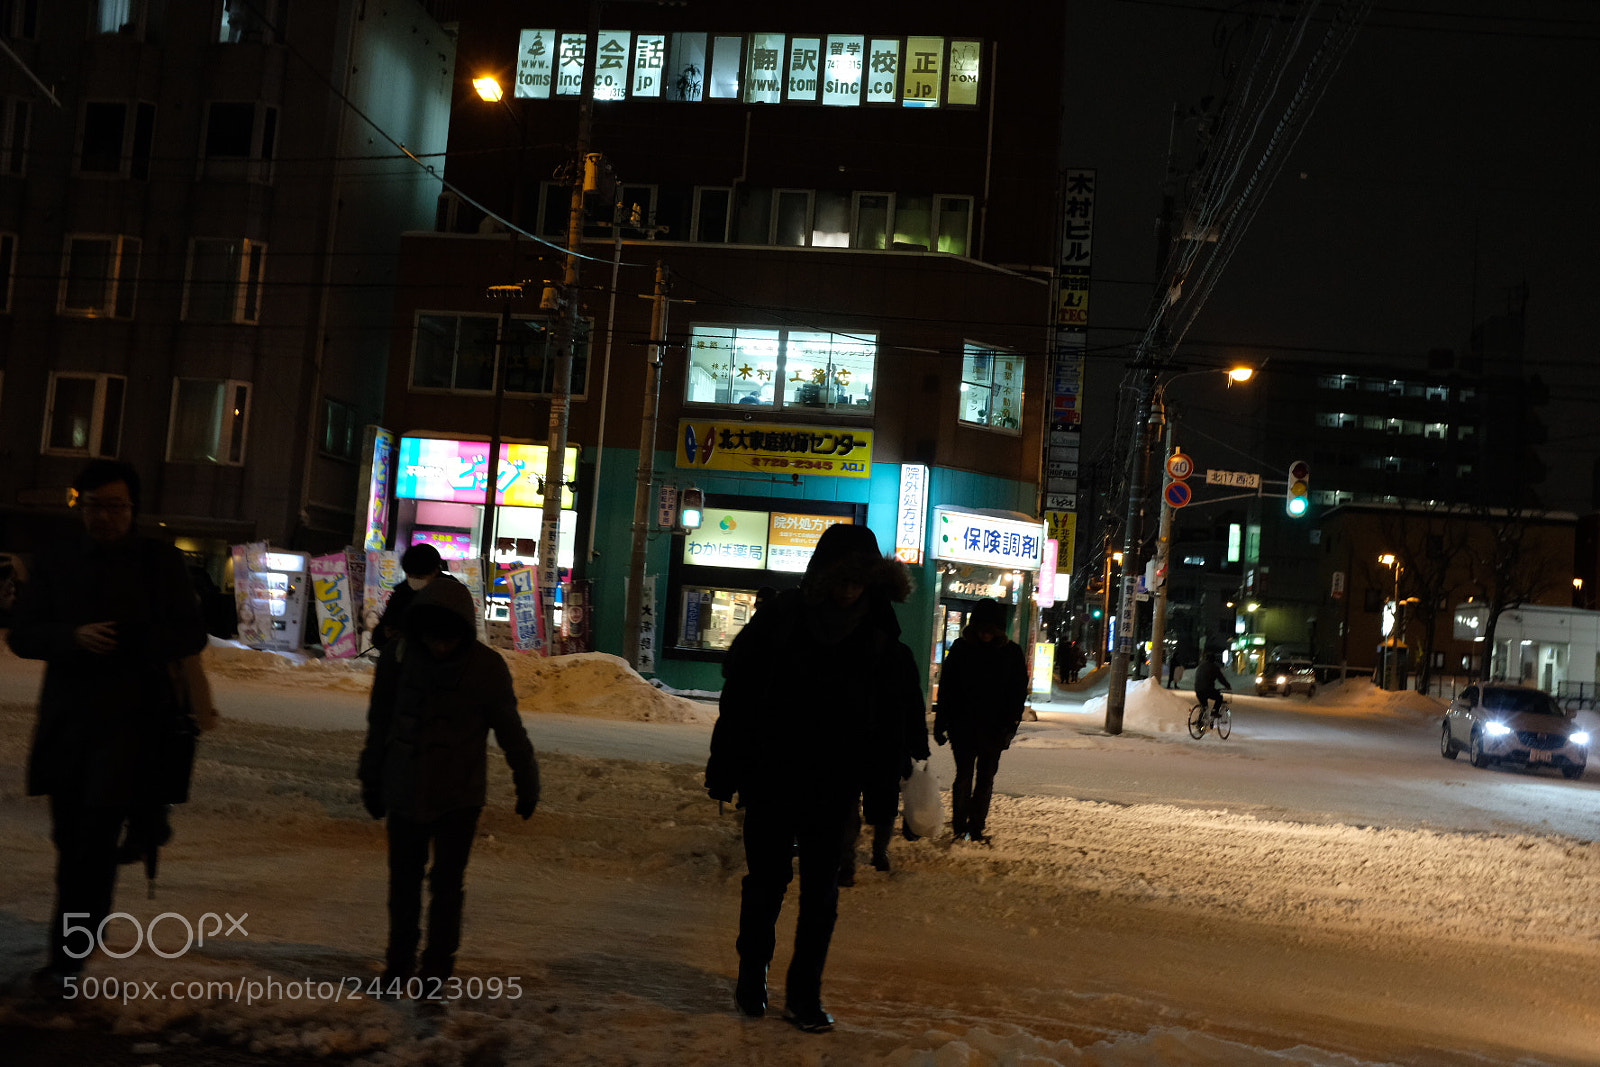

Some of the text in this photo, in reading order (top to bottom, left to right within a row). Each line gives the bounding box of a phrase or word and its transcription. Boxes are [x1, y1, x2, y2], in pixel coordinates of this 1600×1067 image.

[560, 37, 664, 69] 英会話
[753, 48, 817, 71] 翻訳
[830, 41, 861, 56] 留学
[521, 60, 549, 70] www.
[871, 50, 938, 74] 校正
[951, 74, 977, 83] TOM
[1064, 173, 1094, 262] 木村ビル
[719, 428, 867, 456] 北大家庭教師センター
[1172, 461, 1188, 473] 40
[902, 466, 920, 546] 院外処方せん
[773, 515, 846, 532] 院外処方せ
[688, 540, 763, 560] わかば薬局
[963, 526, 1039, 560] 保険調剤
[314, 573, 351, 647] ビッグ
